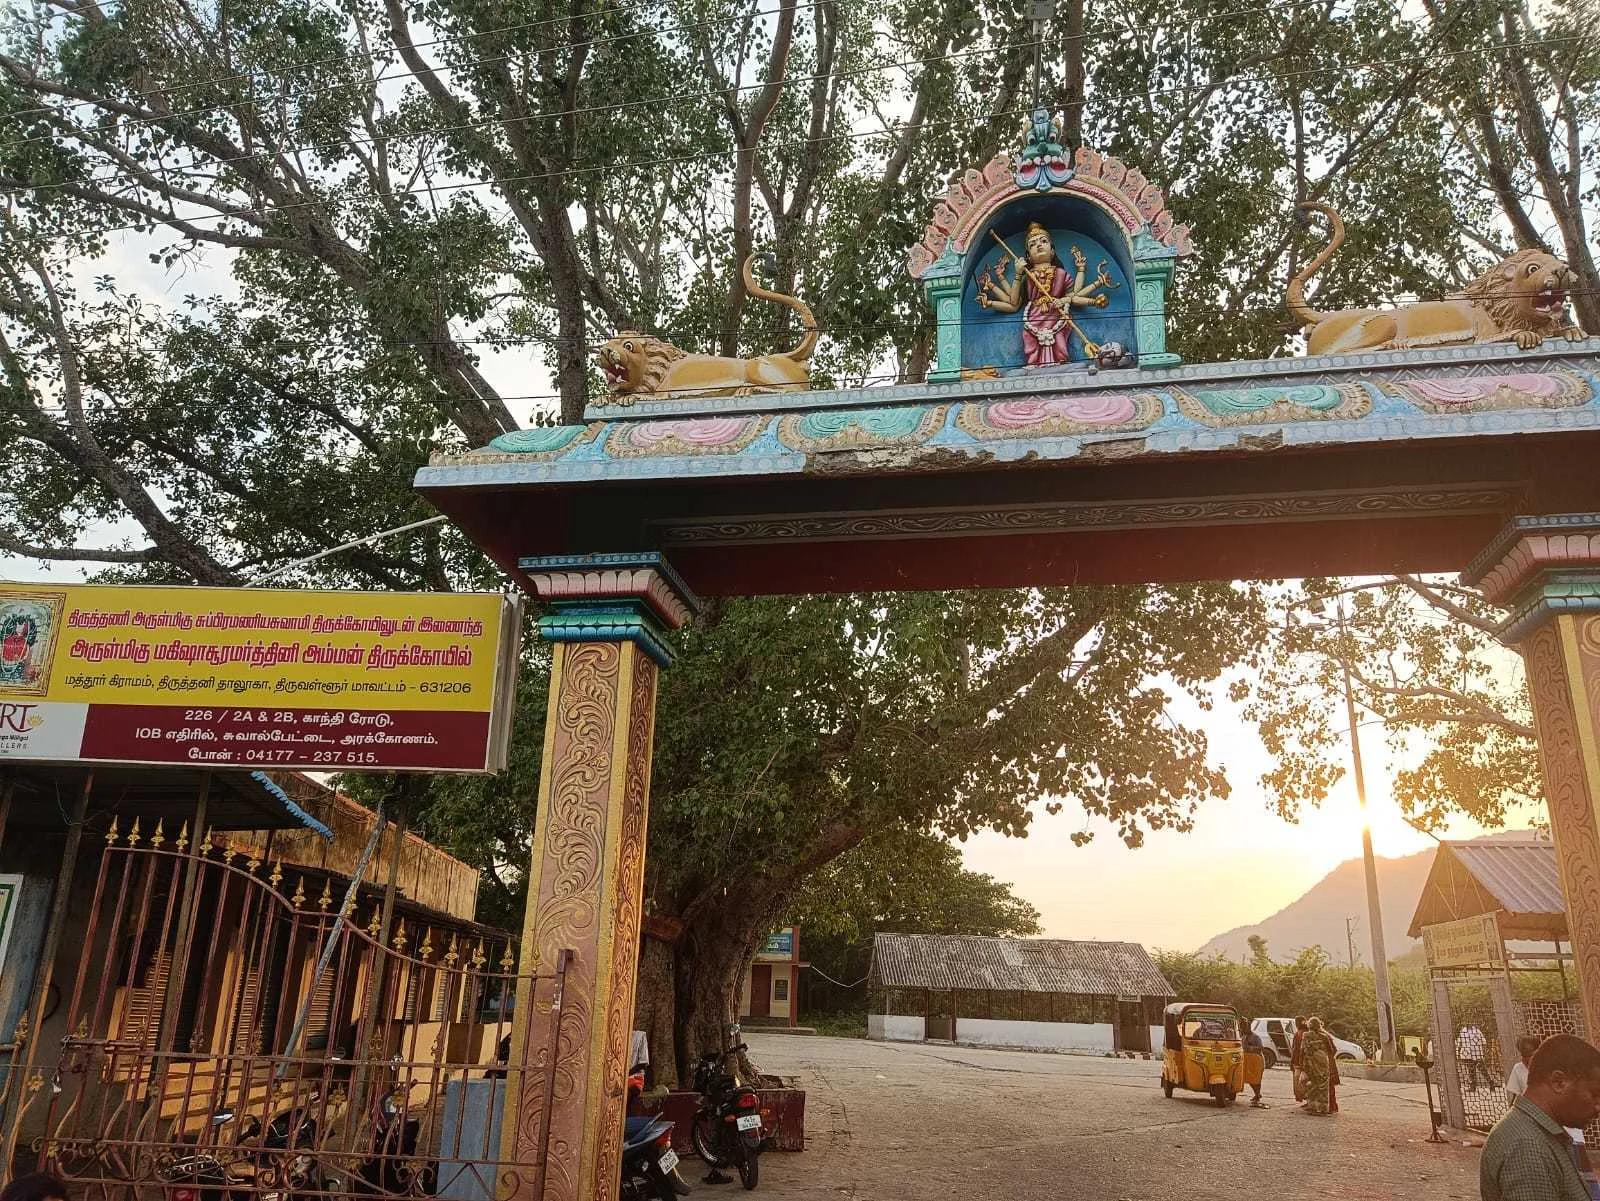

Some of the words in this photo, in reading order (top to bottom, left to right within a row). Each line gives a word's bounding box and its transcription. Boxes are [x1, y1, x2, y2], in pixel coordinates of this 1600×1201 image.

[132, 610, 193, 630] அருள்மிகு
[70, 637, 151, 664] அருள்மிகு
[302, 641, 365, 667] அம்மன்
[365, 643, 473, 671] திருக்கோயில்
[351, 679, 407, 693] மாவட்டம்
[420, 681, 472, 694] 631206
[184, 709, 213, 721] 226
[217, 710, 229, 724] /
[233, 710, 253, 722] 2A
[257, 711, 268, 722] &
[302, 712, 345, 727] காந்தி
[135, 727, 162, 739] IOB
[188, 747, 234, 760] போன்
[246, 749, 295, 761] 04177
[313, 751, 343, 763] 237
